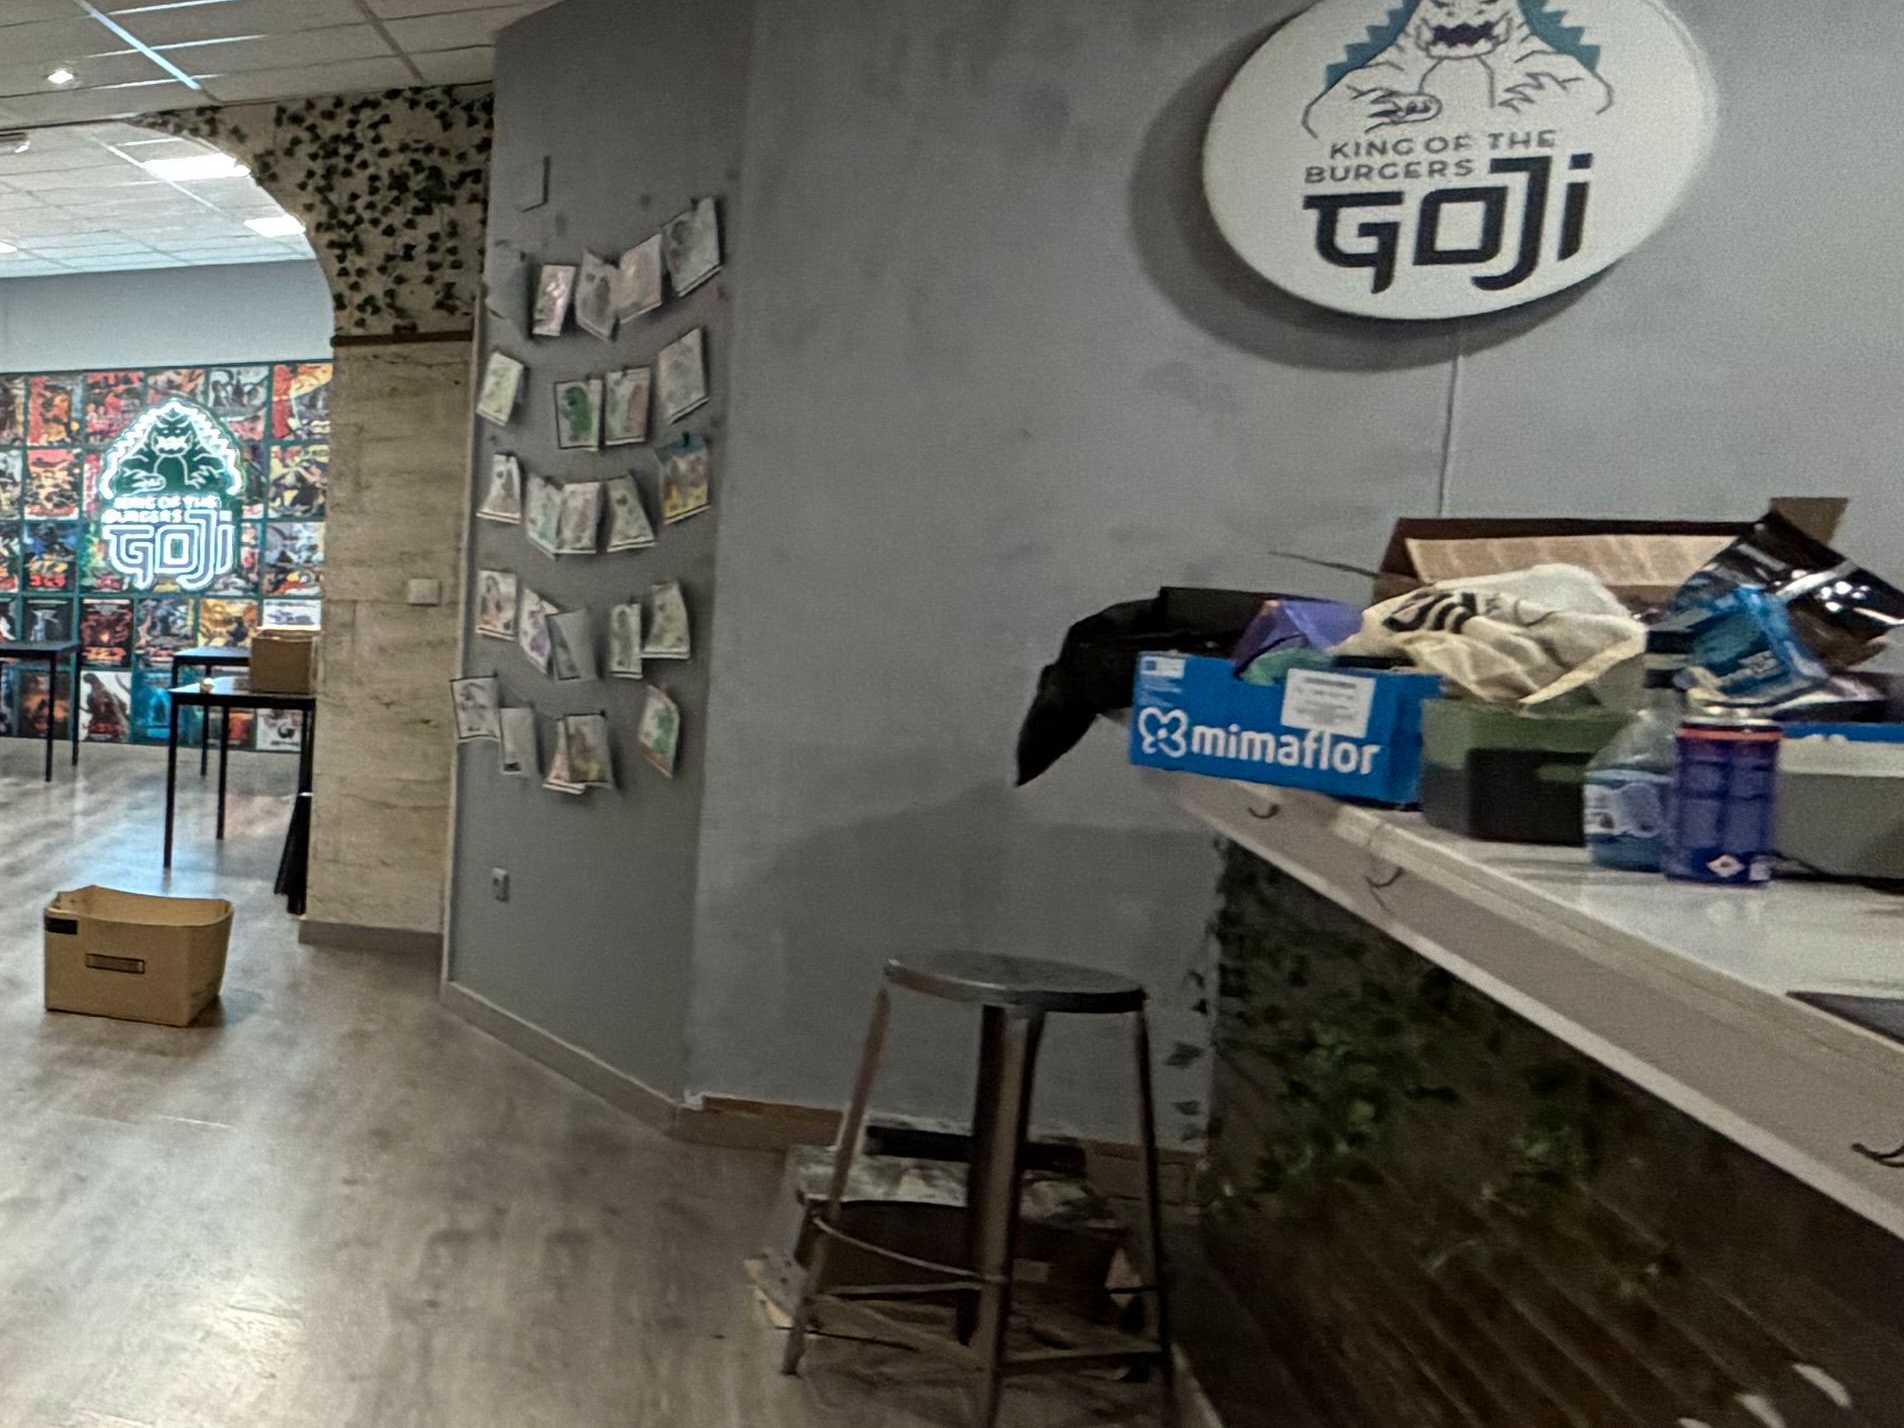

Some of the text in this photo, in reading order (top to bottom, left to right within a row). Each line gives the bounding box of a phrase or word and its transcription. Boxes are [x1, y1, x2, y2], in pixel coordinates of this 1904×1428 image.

[1329, 129, 1556, 160] KING OF THE
[1303, 158, 1474, 184] BURGERS
[1192, 723, 1382, 775] mimaflor
